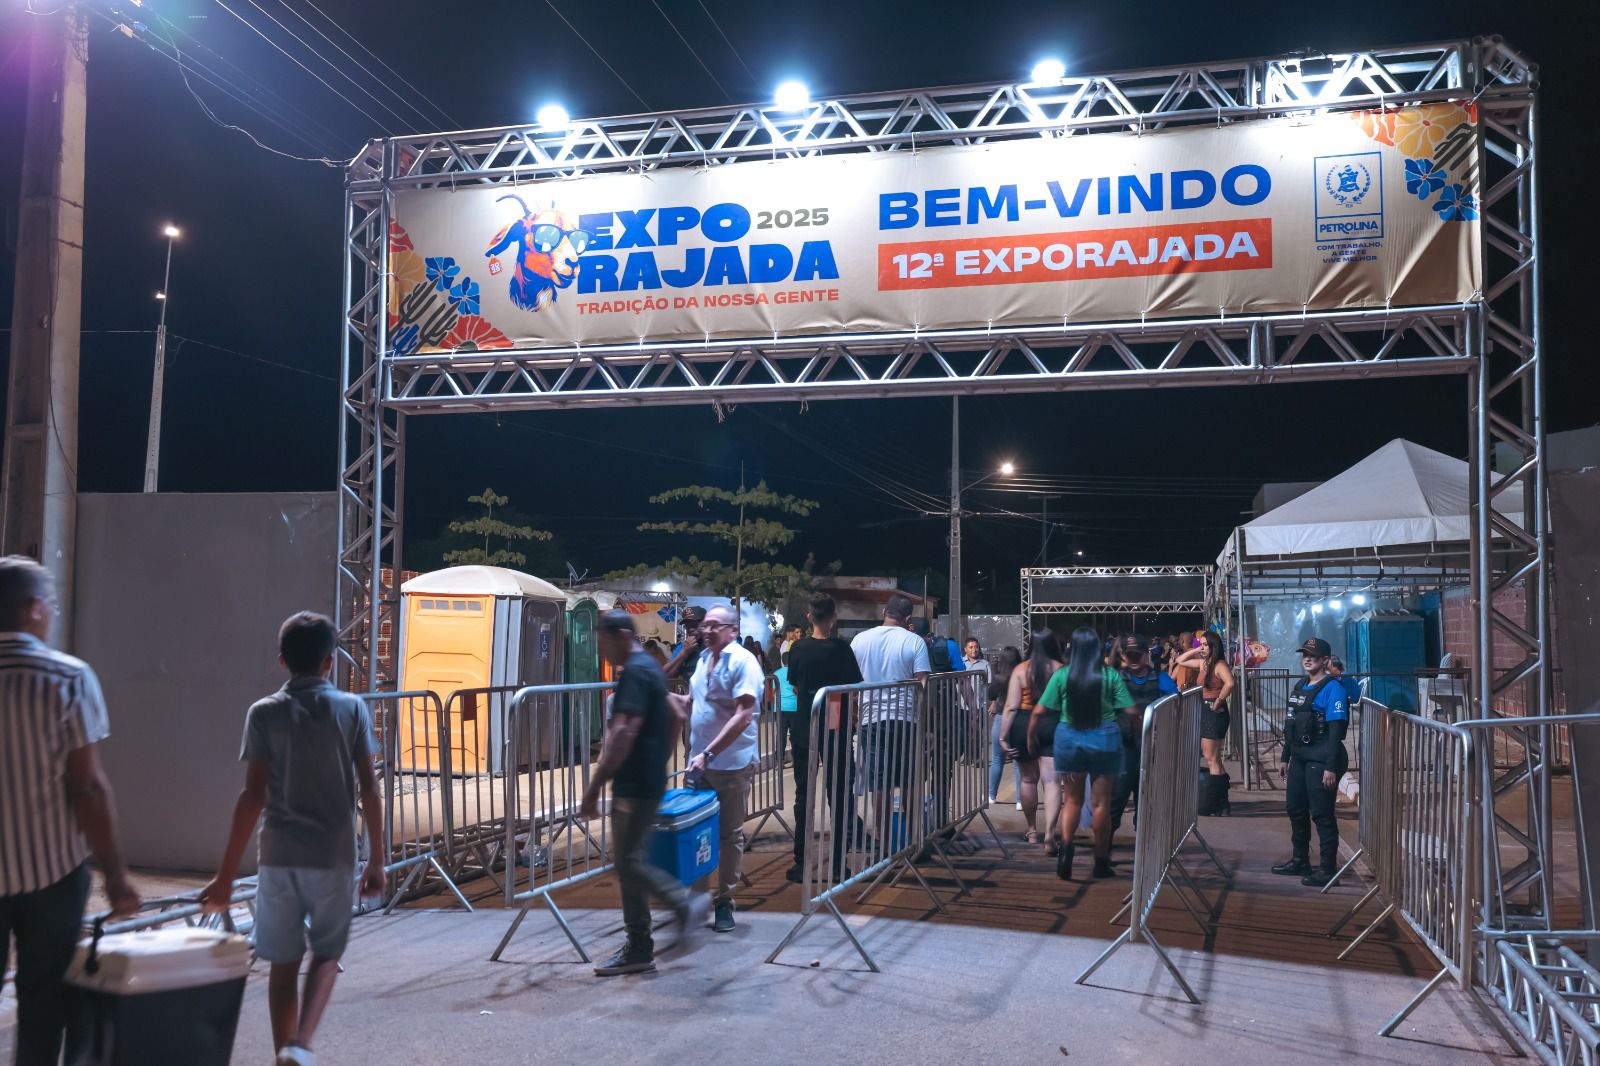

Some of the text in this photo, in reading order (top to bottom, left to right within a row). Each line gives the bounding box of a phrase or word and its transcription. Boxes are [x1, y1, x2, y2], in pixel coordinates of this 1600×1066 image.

[879, 164, 1272, 230] BEM-VINDO
[578, 203, 829, 252] EXPO 2025
[1320, 221, 1378, 234] PETROLINA
[577, 240, 840, 295] RAJADA
[892, 231, 1259, 279] 12ª EXPORAJADA
[577, 288, 839, 315] TRADIÇÃO DA NOSSA GENTE
